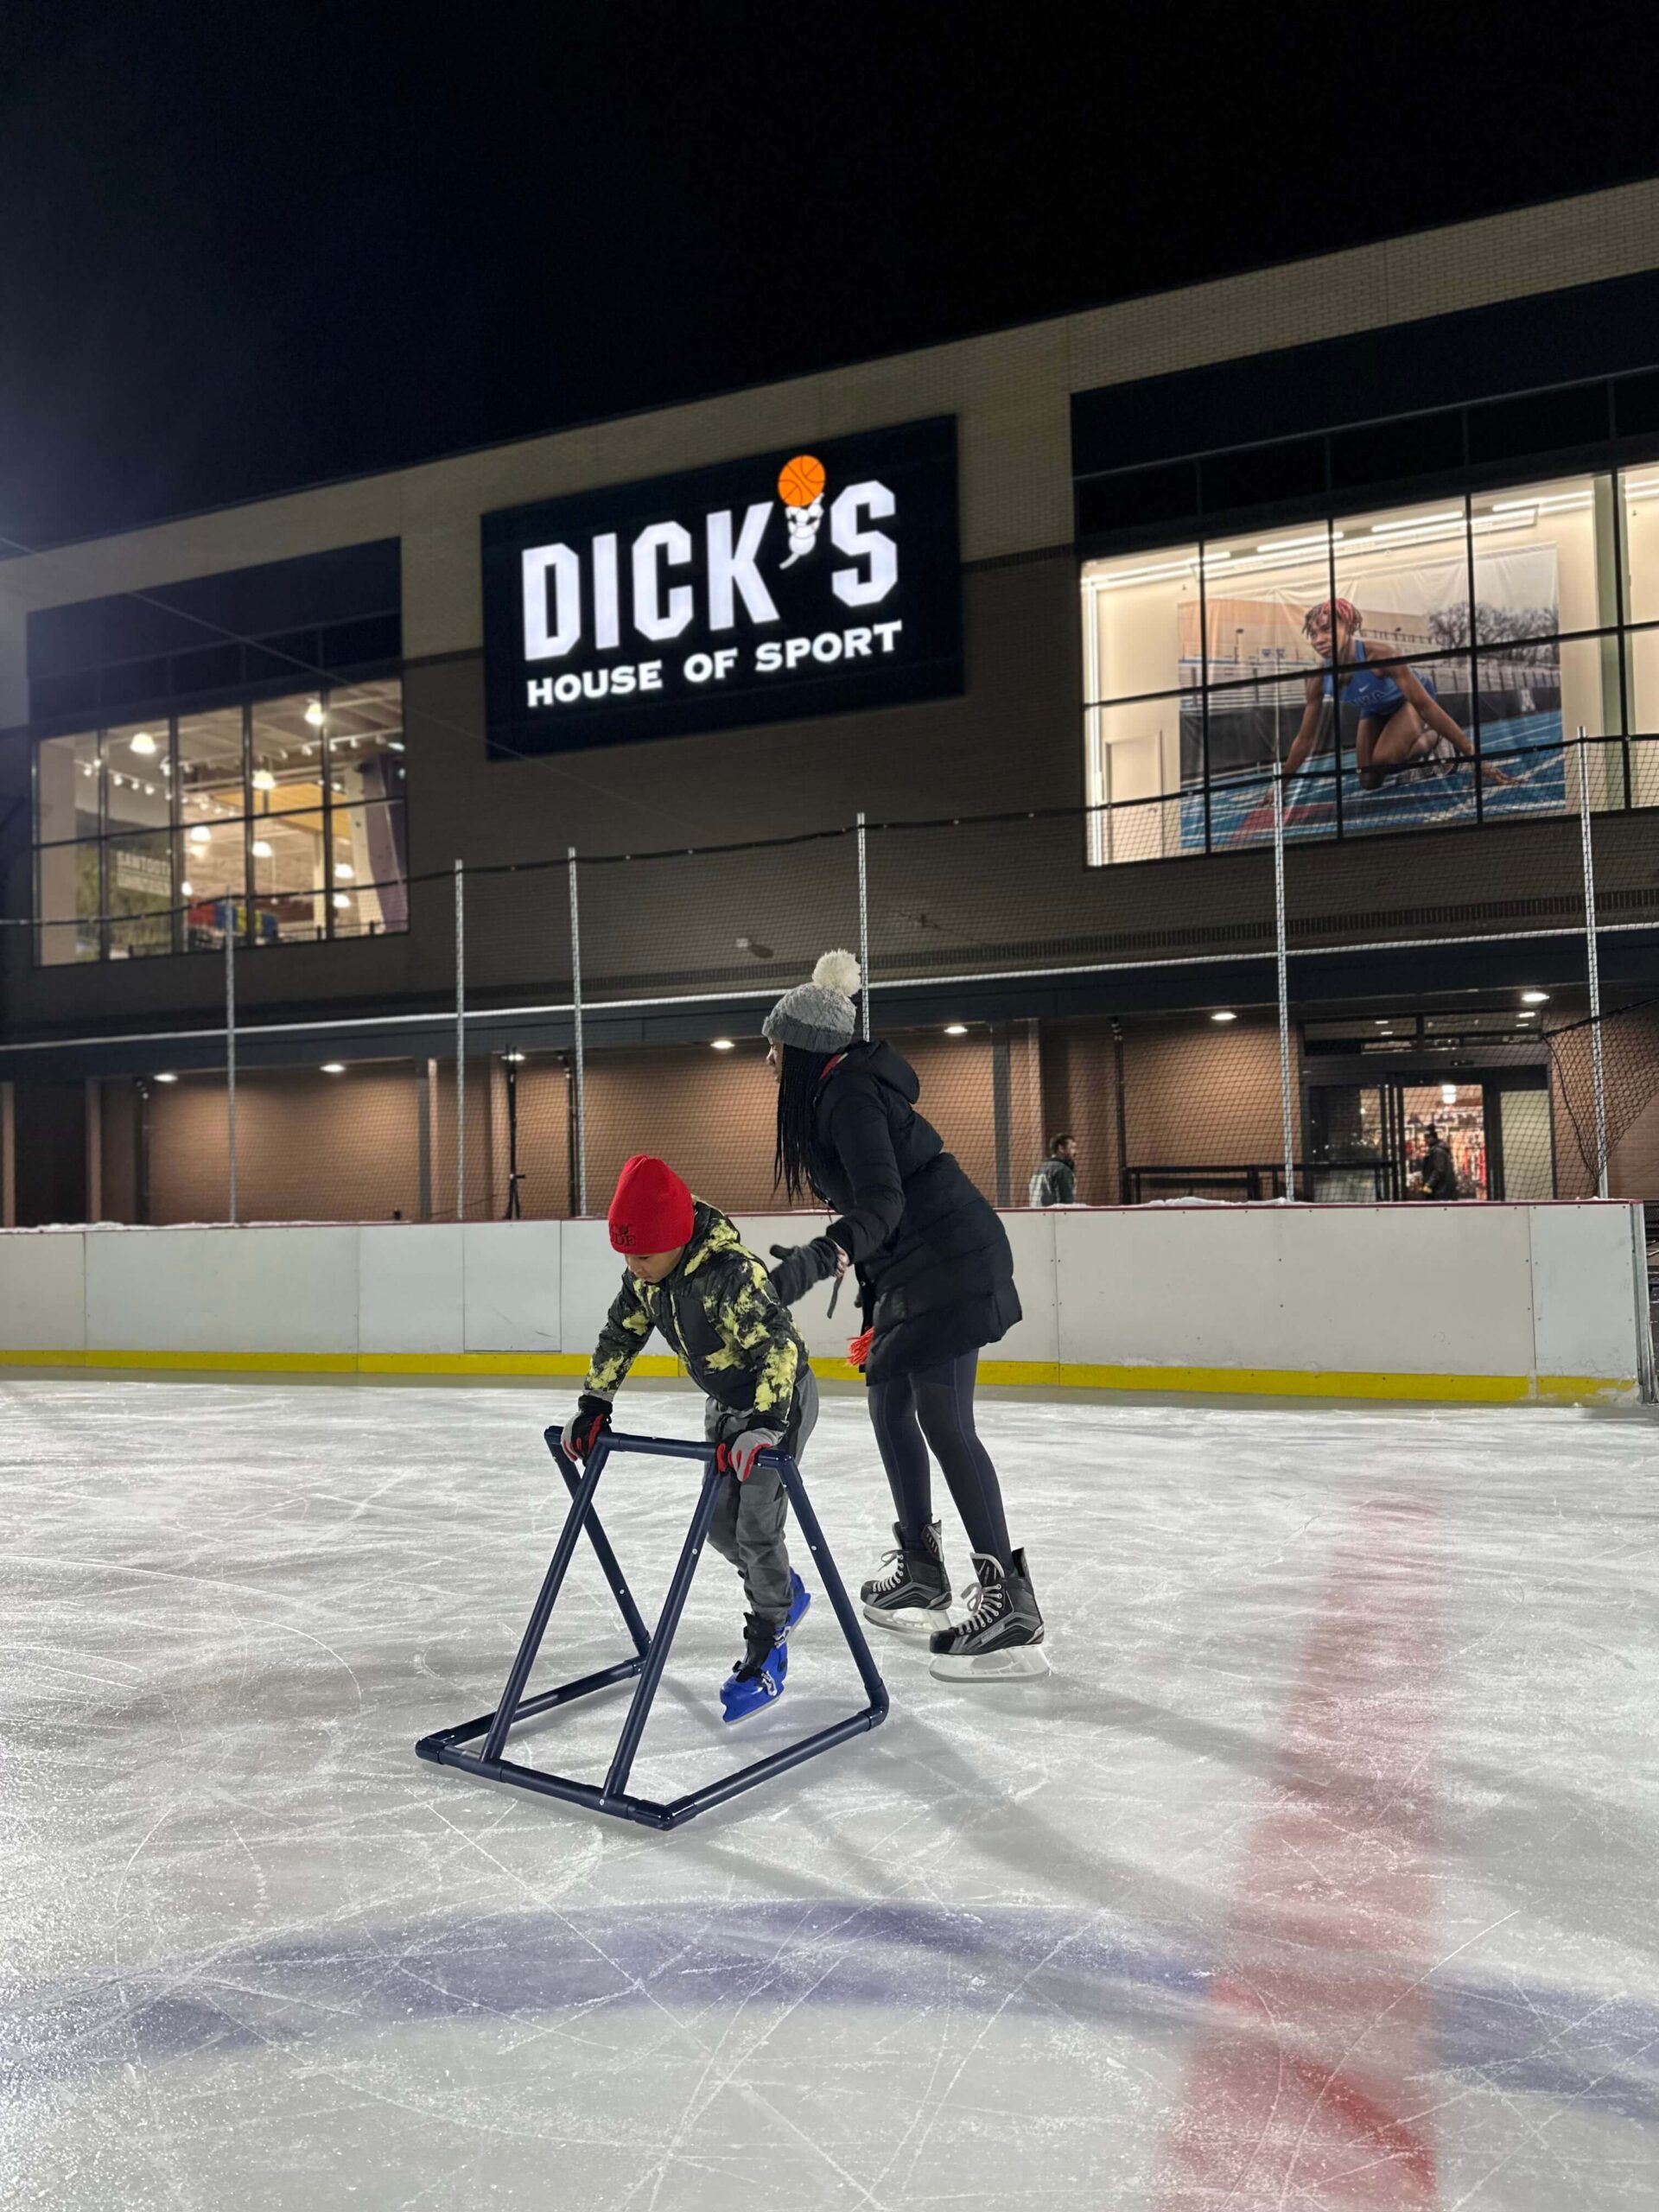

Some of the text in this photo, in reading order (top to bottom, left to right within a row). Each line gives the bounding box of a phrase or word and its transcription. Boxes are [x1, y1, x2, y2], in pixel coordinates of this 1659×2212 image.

[521, 480, 899, 662] DICK'S
[526, 619, 903, 709] HOUSE OF SPORT
